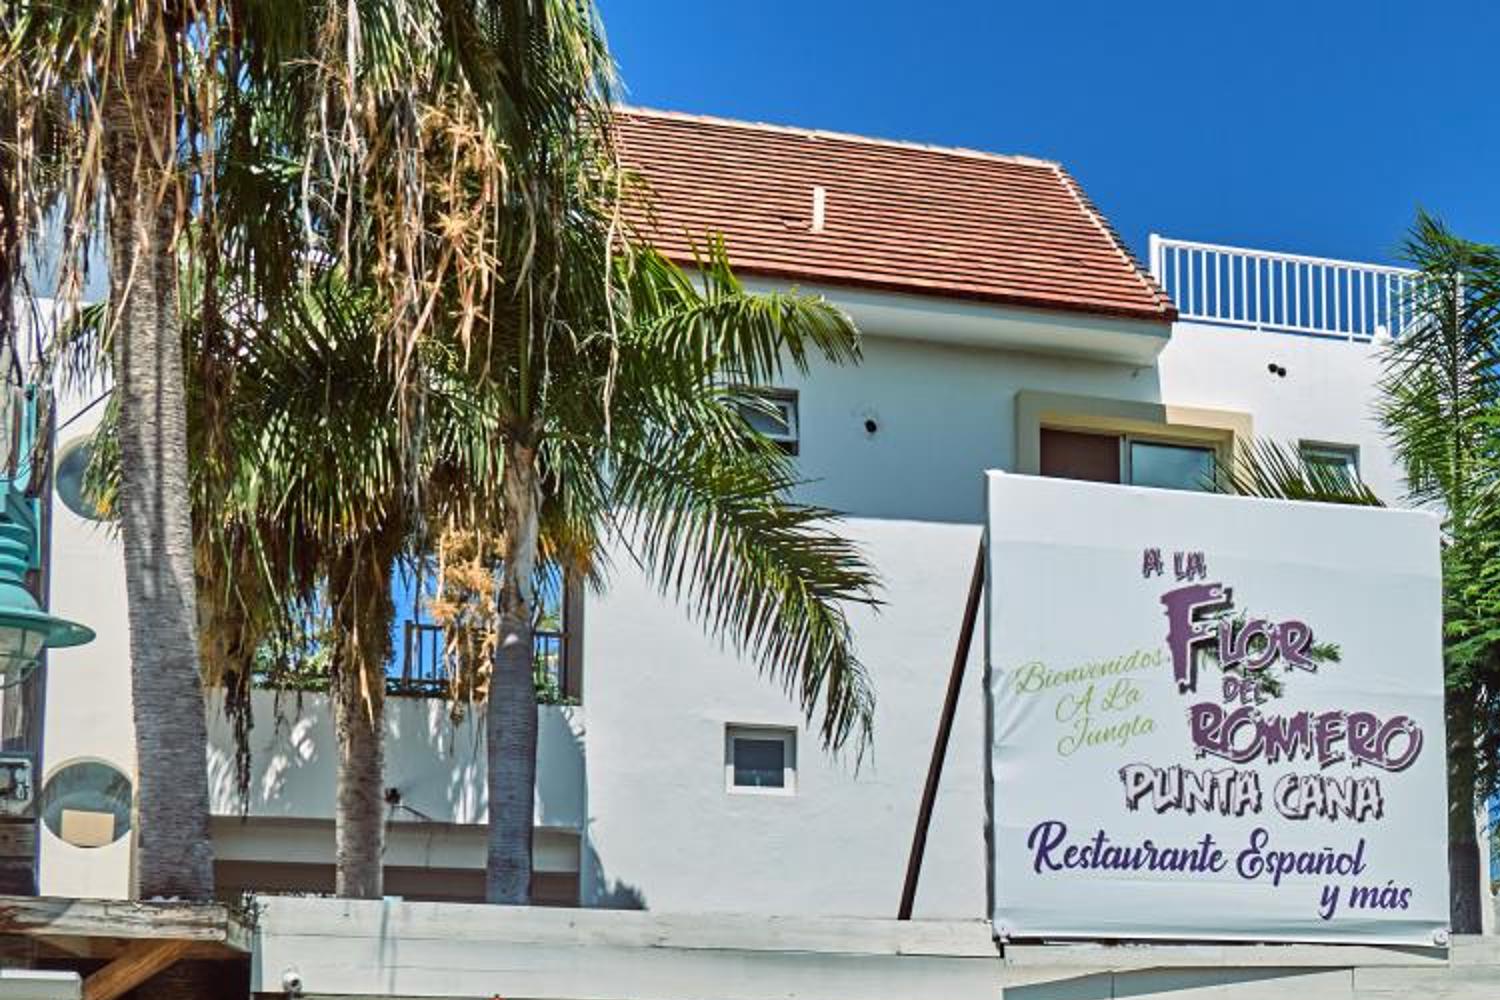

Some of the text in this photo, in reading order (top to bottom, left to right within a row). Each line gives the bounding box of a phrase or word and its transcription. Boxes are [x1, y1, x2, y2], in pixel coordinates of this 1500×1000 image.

[1142, 548, 1207, 581] A LA
[1015, 650, 1163, 695] Bienvenidos
[1222, 675, 1268, 705] DEL
[1056, 678, 1143, 722] A La
[1057, 716, 1154, 757] Jungla
[1188, 702, 1423, 773] ROMERO
[1119, 764, 1385, 822] PUNTA CANA
[1027, 821, 1366, 887] Restaurante Español
[1318, 880, 1413, 920] y más
